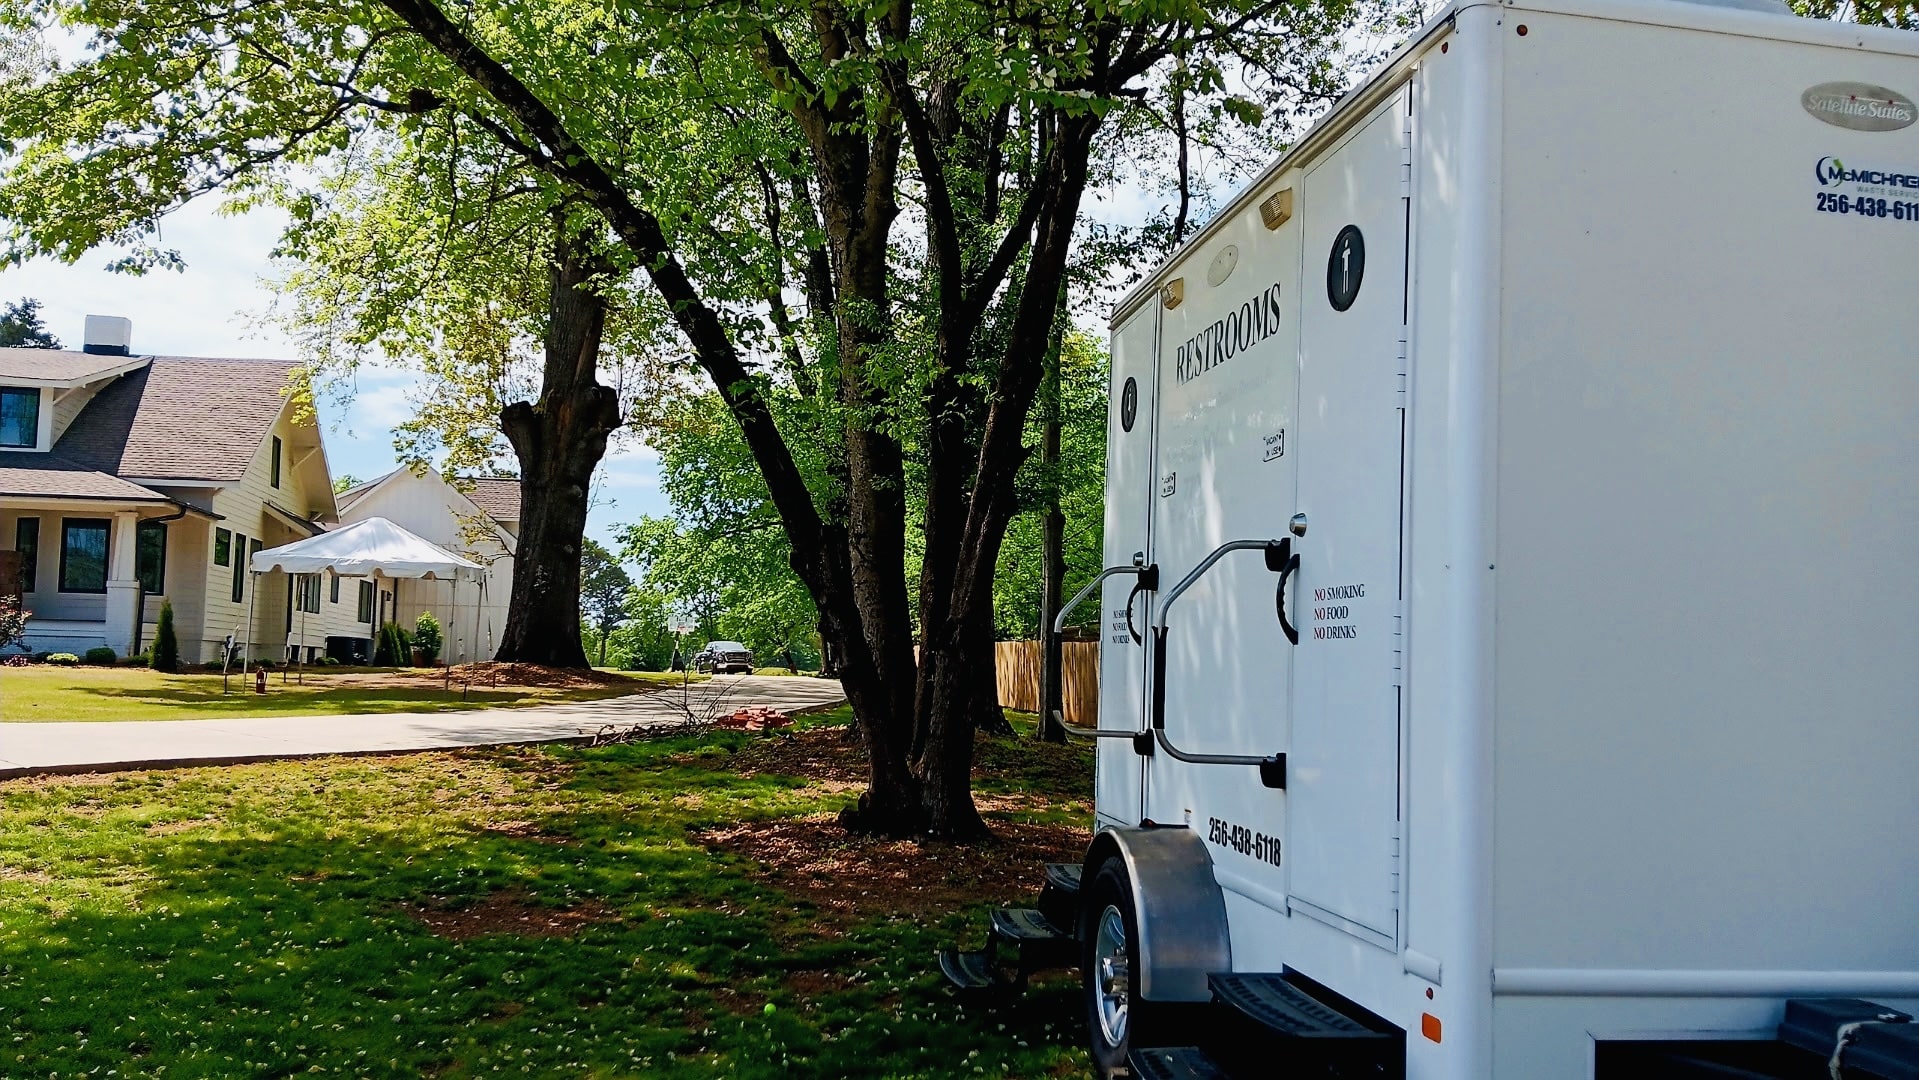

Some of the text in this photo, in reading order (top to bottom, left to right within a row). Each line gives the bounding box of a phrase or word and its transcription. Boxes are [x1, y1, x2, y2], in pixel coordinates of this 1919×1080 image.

[1807, 94, 1912, 121] Satellite Suites
[1828, 166, 1919, 188] McMICHAE
[1888, 189, 1919, 199] SERVIC
[1816, 192, 1919, 221] 256-438-611
[1176, 281, 1281, 385] RESTROOMS
[1314, 584, 1365, 601] NO SMOKING
[1314, 606, 1349, 621] NO FOOD
[1313, 625, 1357, 640] NO DRINKS
[1208, 816, 1282, 867] 256-438-6118
